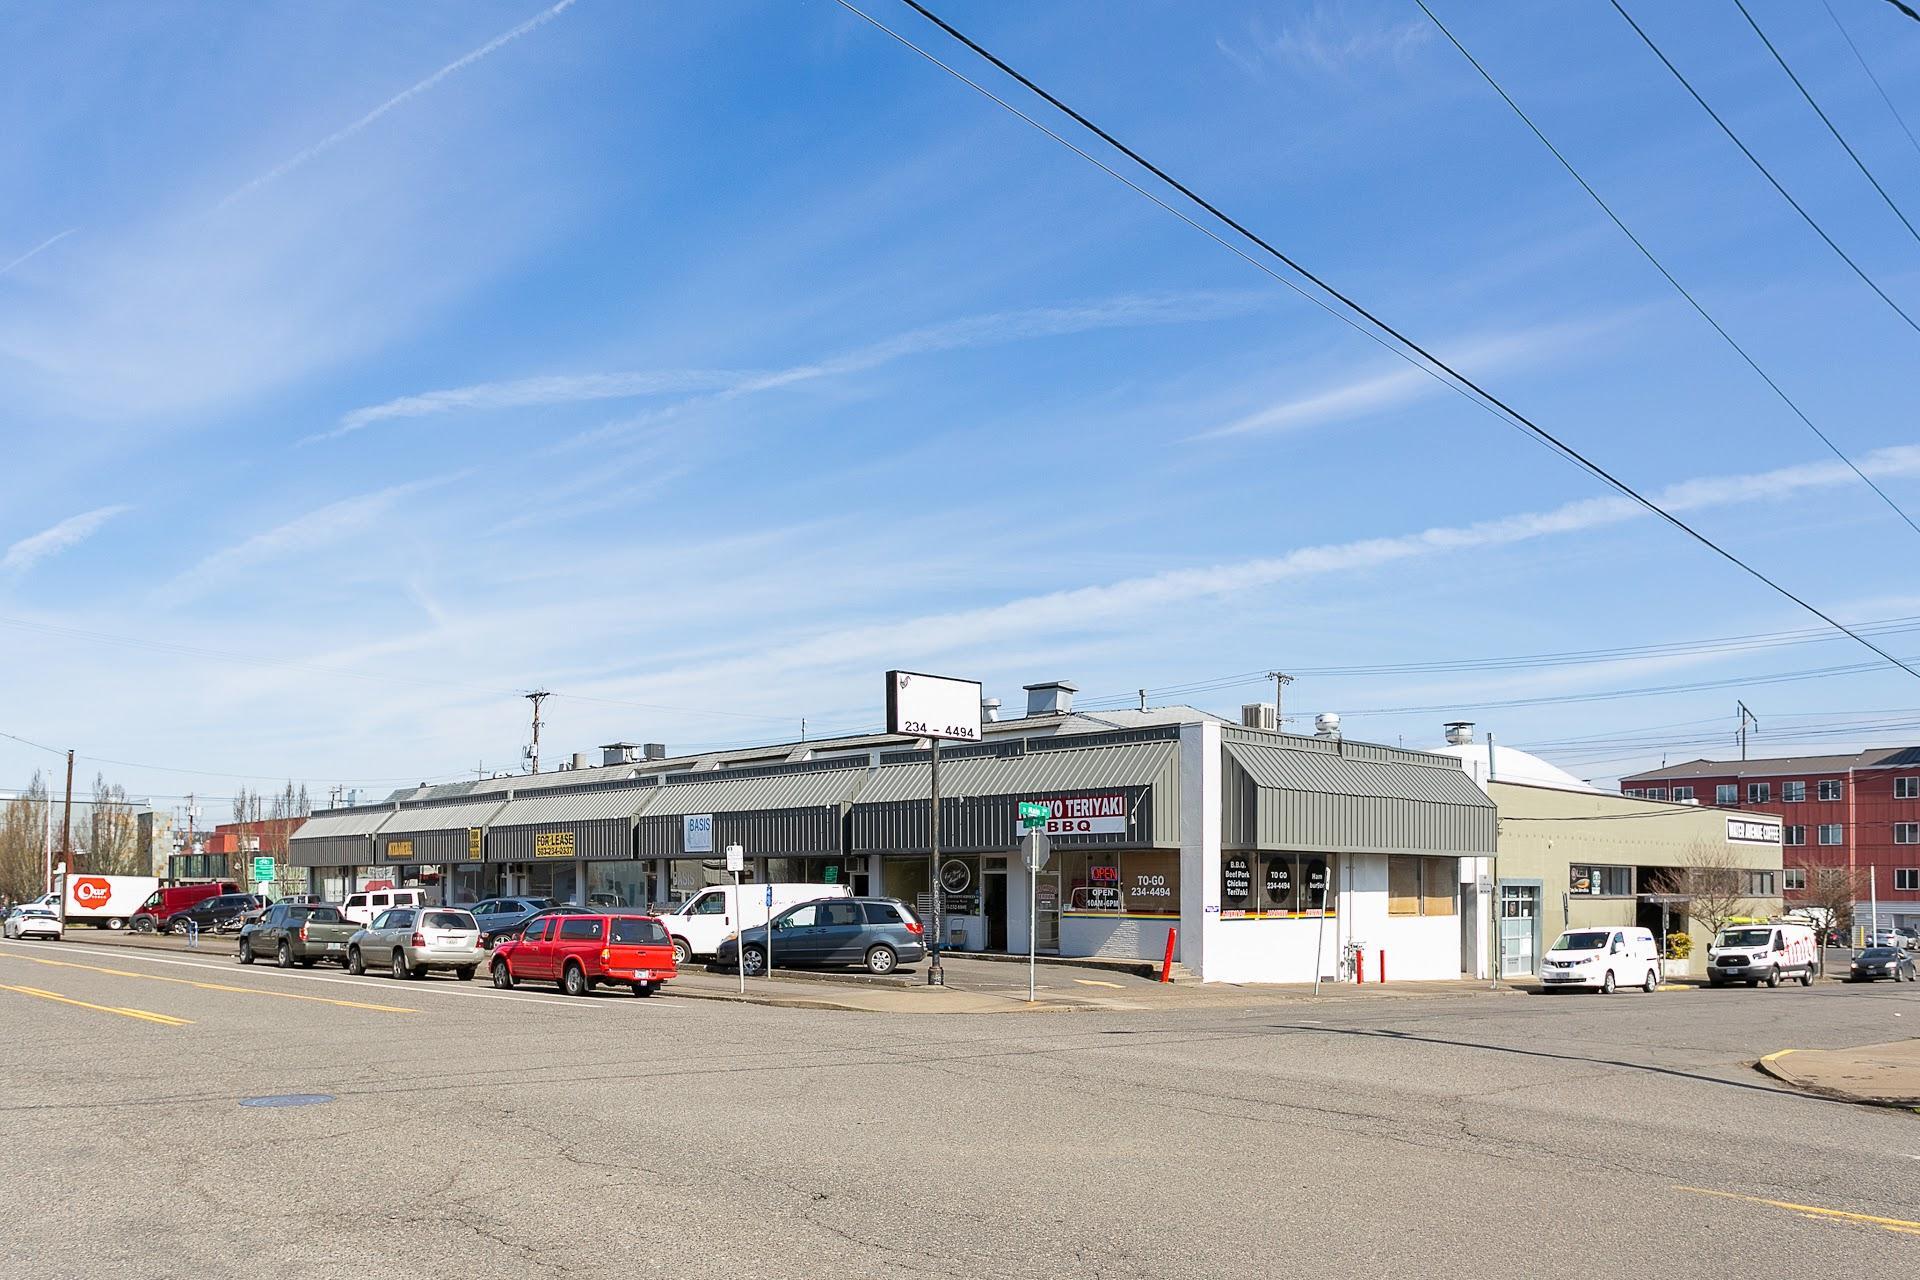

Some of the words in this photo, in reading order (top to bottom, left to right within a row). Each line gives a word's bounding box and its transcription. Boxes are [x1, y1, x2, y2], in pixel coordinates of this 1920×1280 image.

[905, 721, 927, 733] 234
[945, 725, 974, 738] 4494
[1066, 796, 1123, 817] TERIYAKI
[689, 817, 711, 832] BASIS
[1047, 820, 1091, 832] BBQ
[536, 835, 549, 846] FOR
[551, 834, 574, 846] LEASE
[1093, 867, 1117, 880] OPEN
[1225, 870, 1238, 878] Beef
[1238, 870, 1250, 878] Pork
[1271, 871, 1278, 879] TO
[1279, 871, 1288, 879] GO
[1137, 875, 1165, 886] TO-GO
